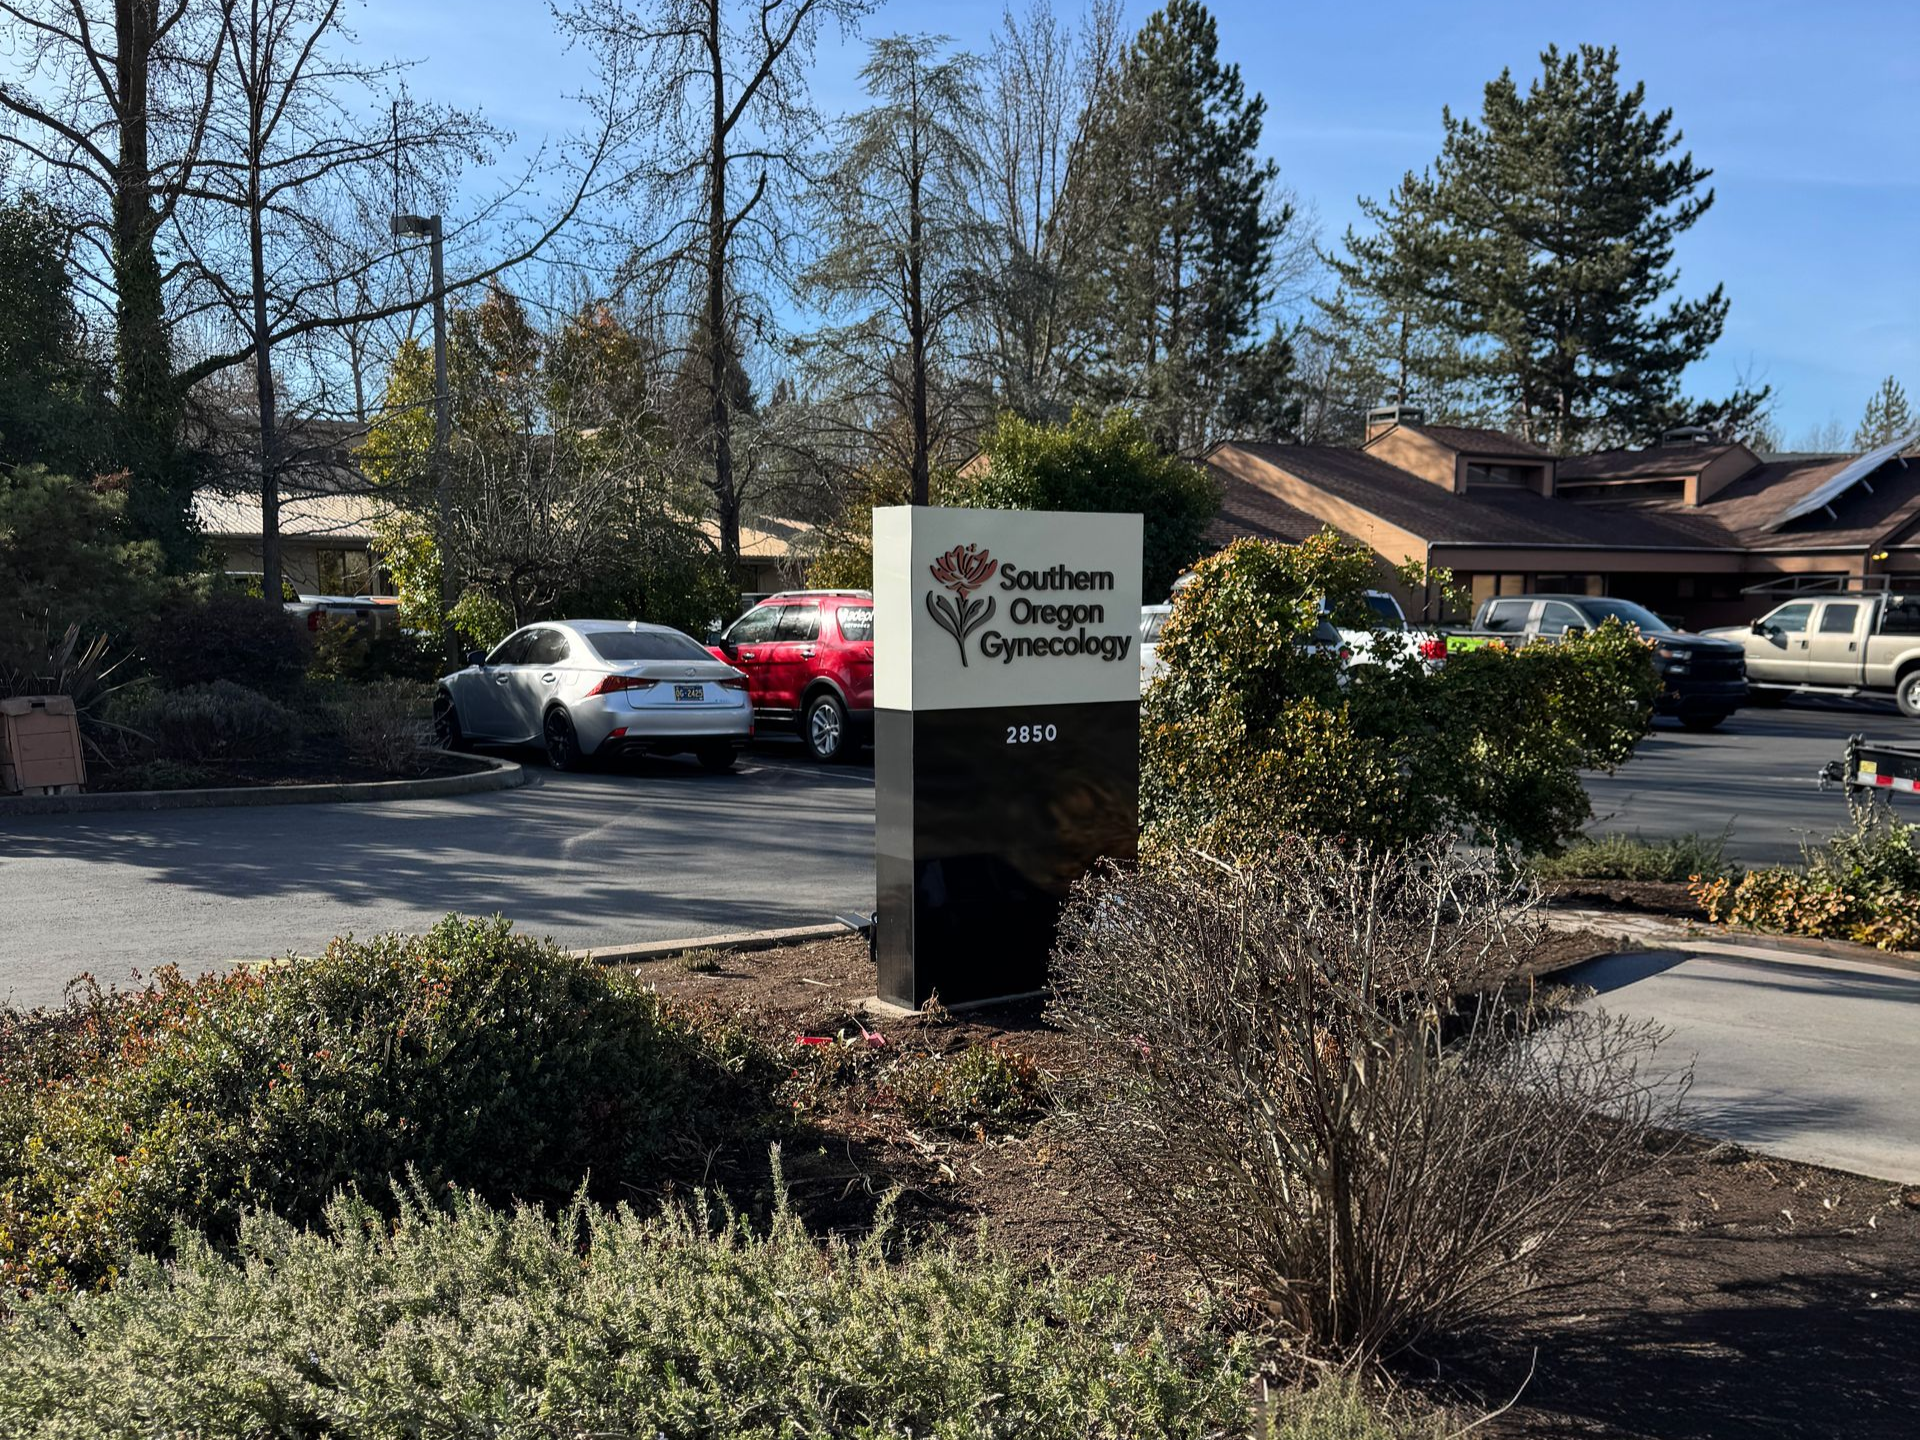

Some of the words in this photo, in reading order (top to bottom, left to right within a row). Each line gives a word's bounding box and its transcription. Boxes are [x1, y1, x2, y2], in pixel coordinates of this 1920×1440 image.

[1000, 563, 1114, 591] Southern
[1010, 597, 1105, 631] Oregon
[980, 627, 1132, 664] Gynecology
[1006, 723, 1057, 744] 2850
